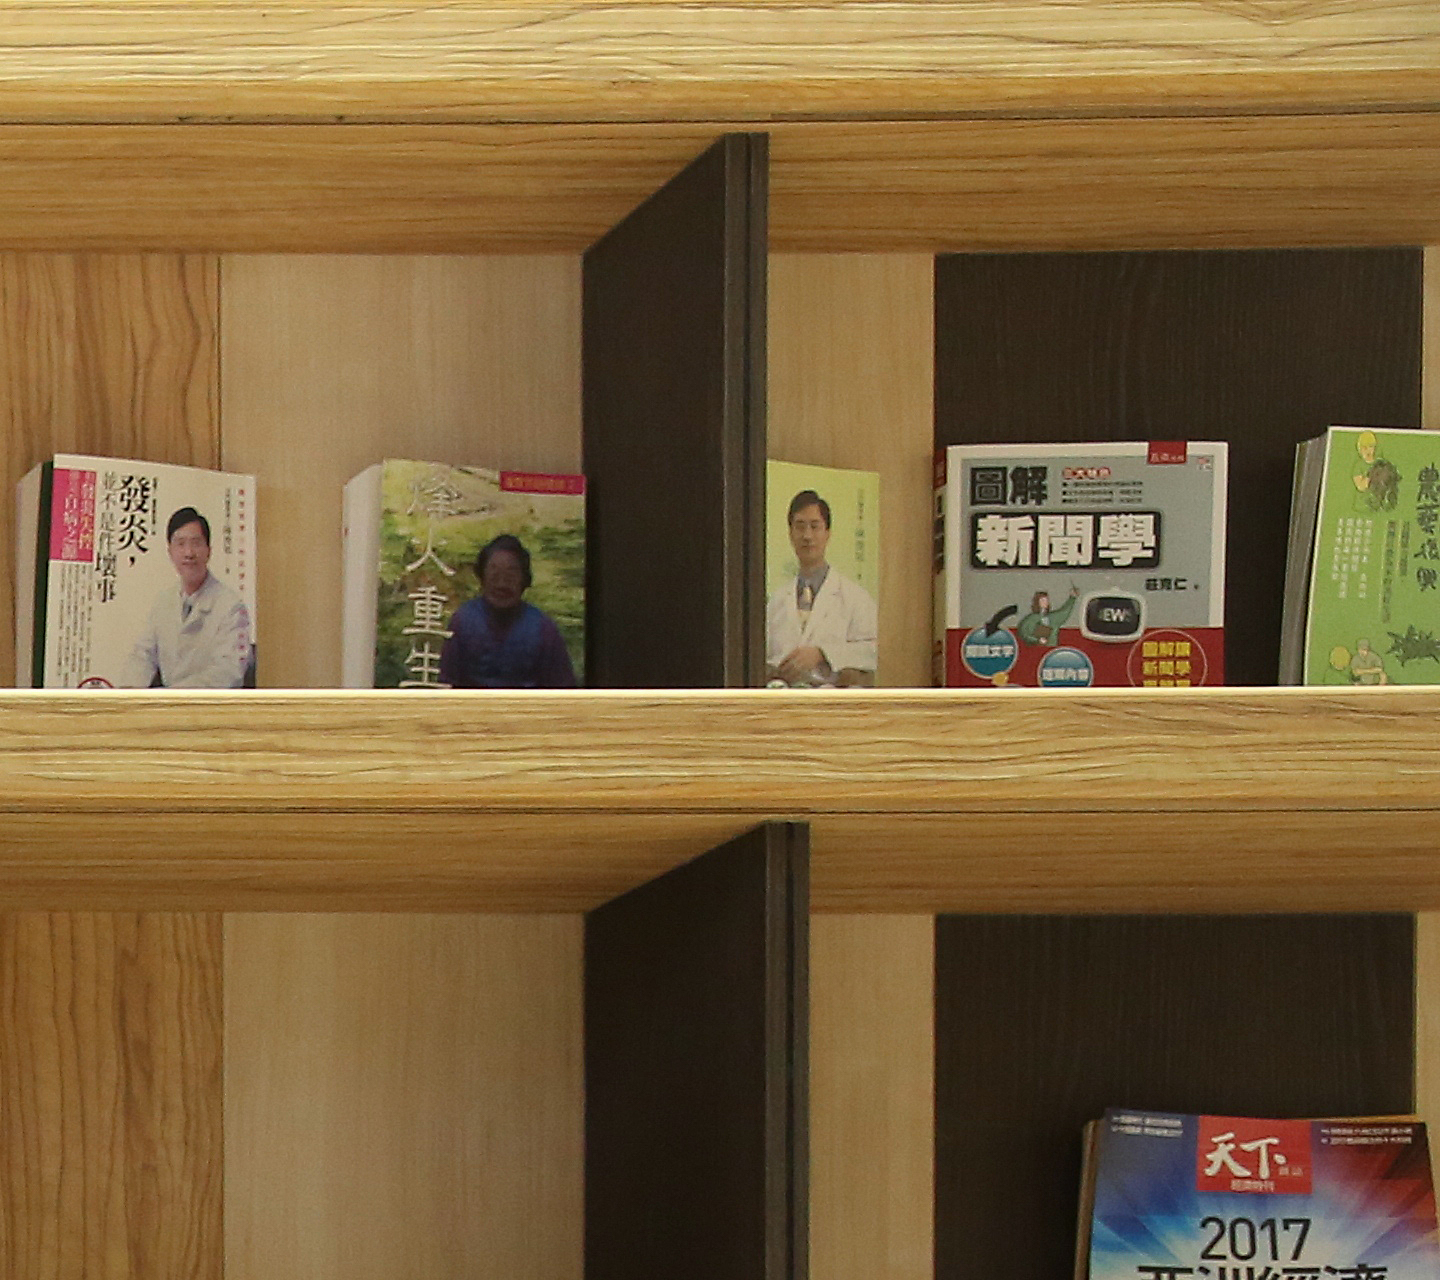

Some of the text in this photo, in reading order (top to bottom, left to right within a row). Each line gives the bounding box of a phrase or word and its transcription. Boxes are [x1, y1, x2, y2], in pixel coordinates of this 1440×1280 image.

[970, 466, 1048, 506] 圖解
[976, 514, 1157, 567] 新聞學
[1204, 1131, 1280, 1180] 天下
[1200, 1217, 1311, 1262] 2017
